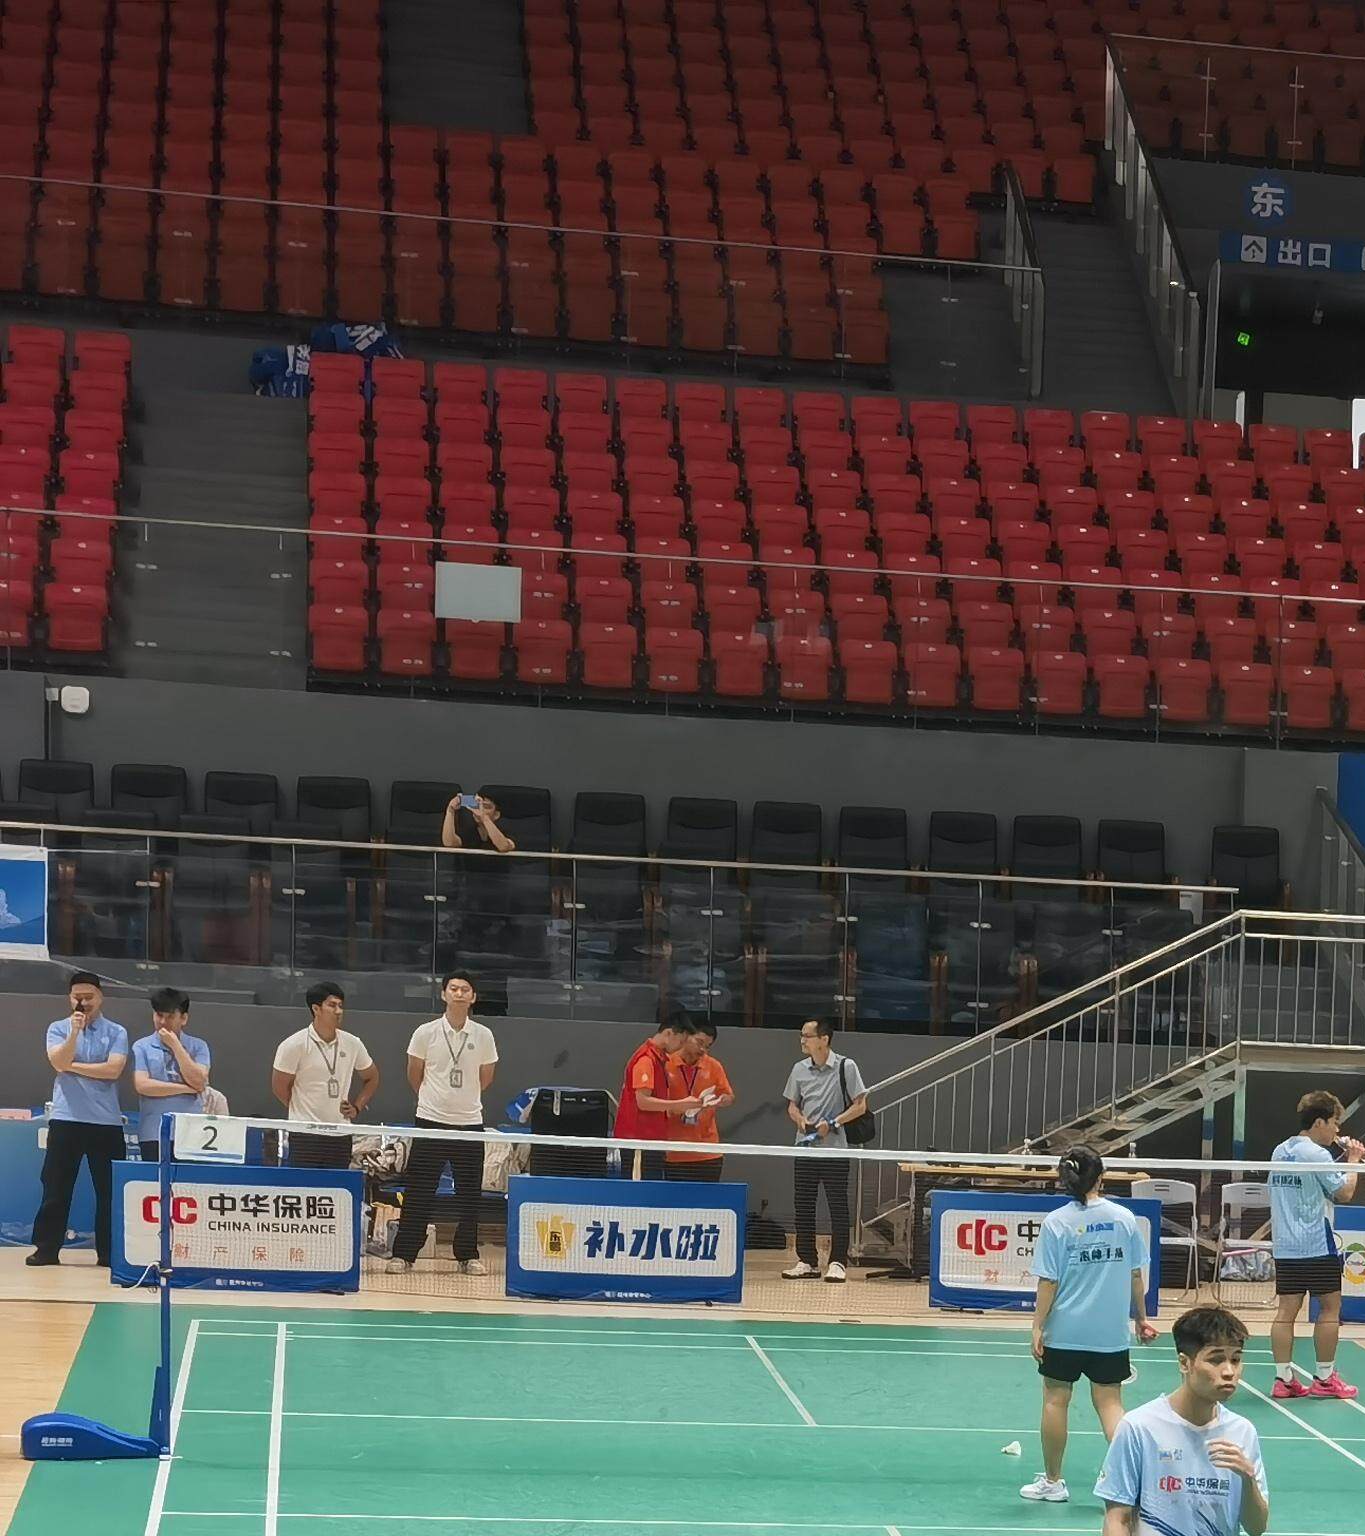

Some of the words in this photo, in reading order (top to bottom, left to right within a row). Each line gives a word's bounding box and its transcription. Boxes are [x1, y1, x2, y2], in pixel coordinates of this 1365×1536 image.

[1250, 182, 1286, 219] 东
[1277, 238, 1333, 269] 出口
[201, 1125, 218, 1151] 2
[207, 1192, 337, 1220] 中华保险
[207, 1220, 252, 1233] CHINA
[256, 1221, 337, 1235] INSURANCE
[583, 1220, 721, 1263] 补水啦
